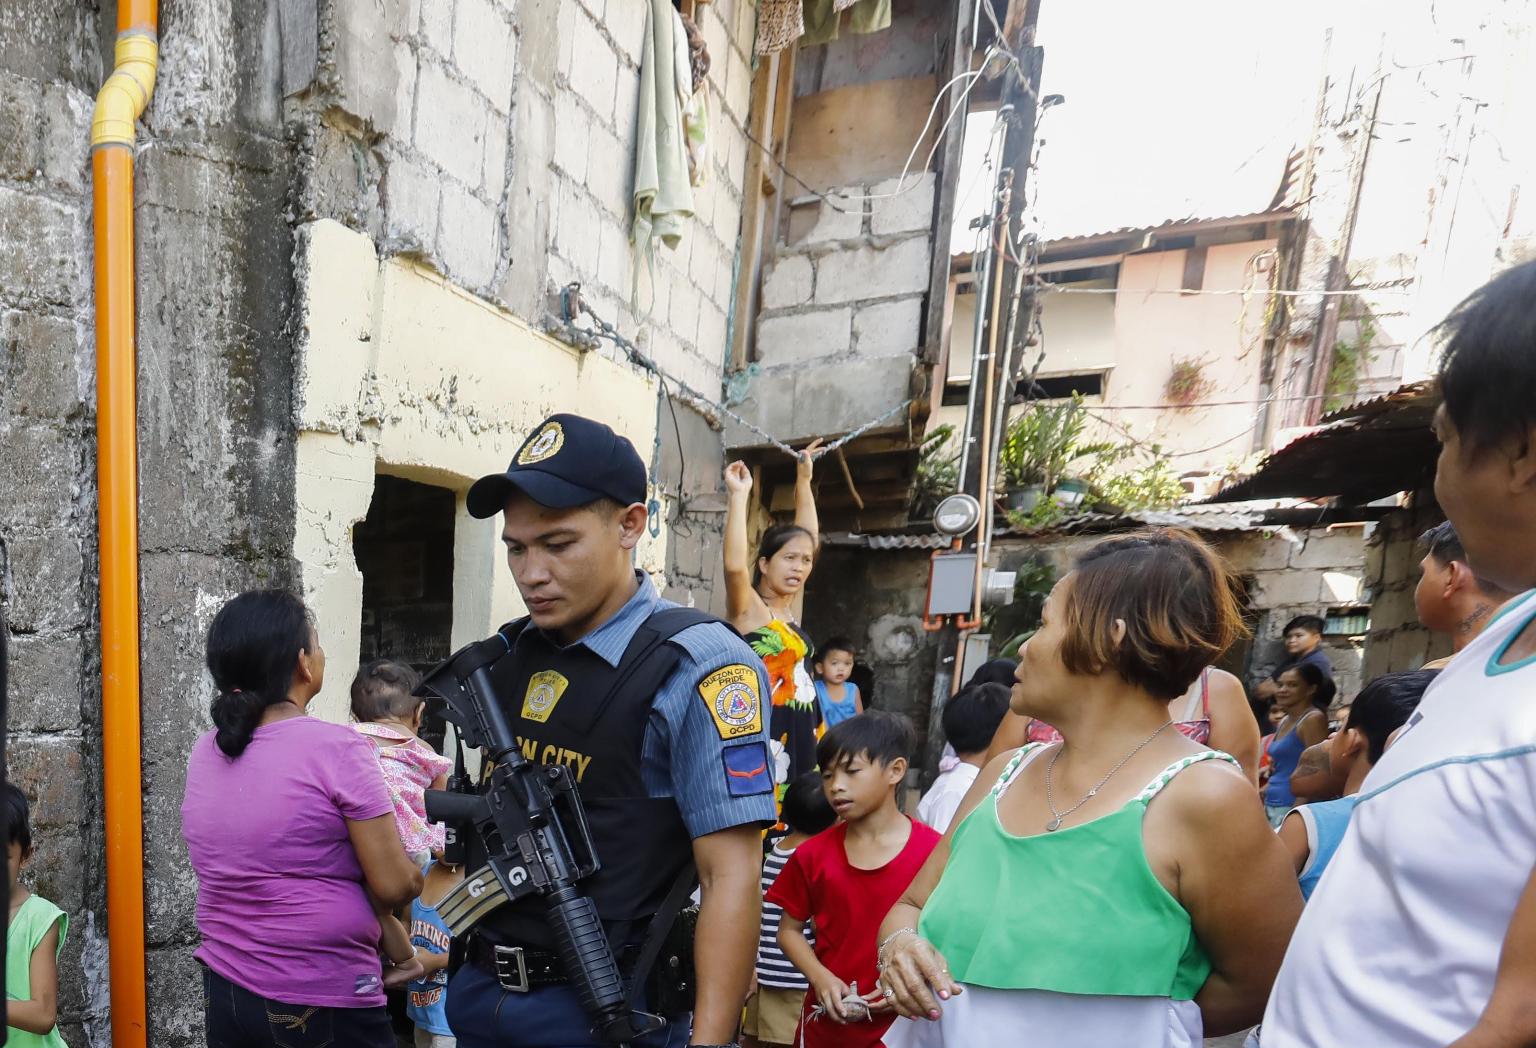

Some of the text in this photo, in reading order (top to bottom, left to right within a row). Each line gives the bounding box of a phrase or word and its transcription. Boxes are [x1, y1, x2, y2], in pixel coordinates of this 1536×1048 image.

[702, 670, 733, 688] QUEZON
[719, 674, 745, 686] PRIDE
[729, 724, 755, 735] QCPD
[541, 744, 592, 783] CITY
